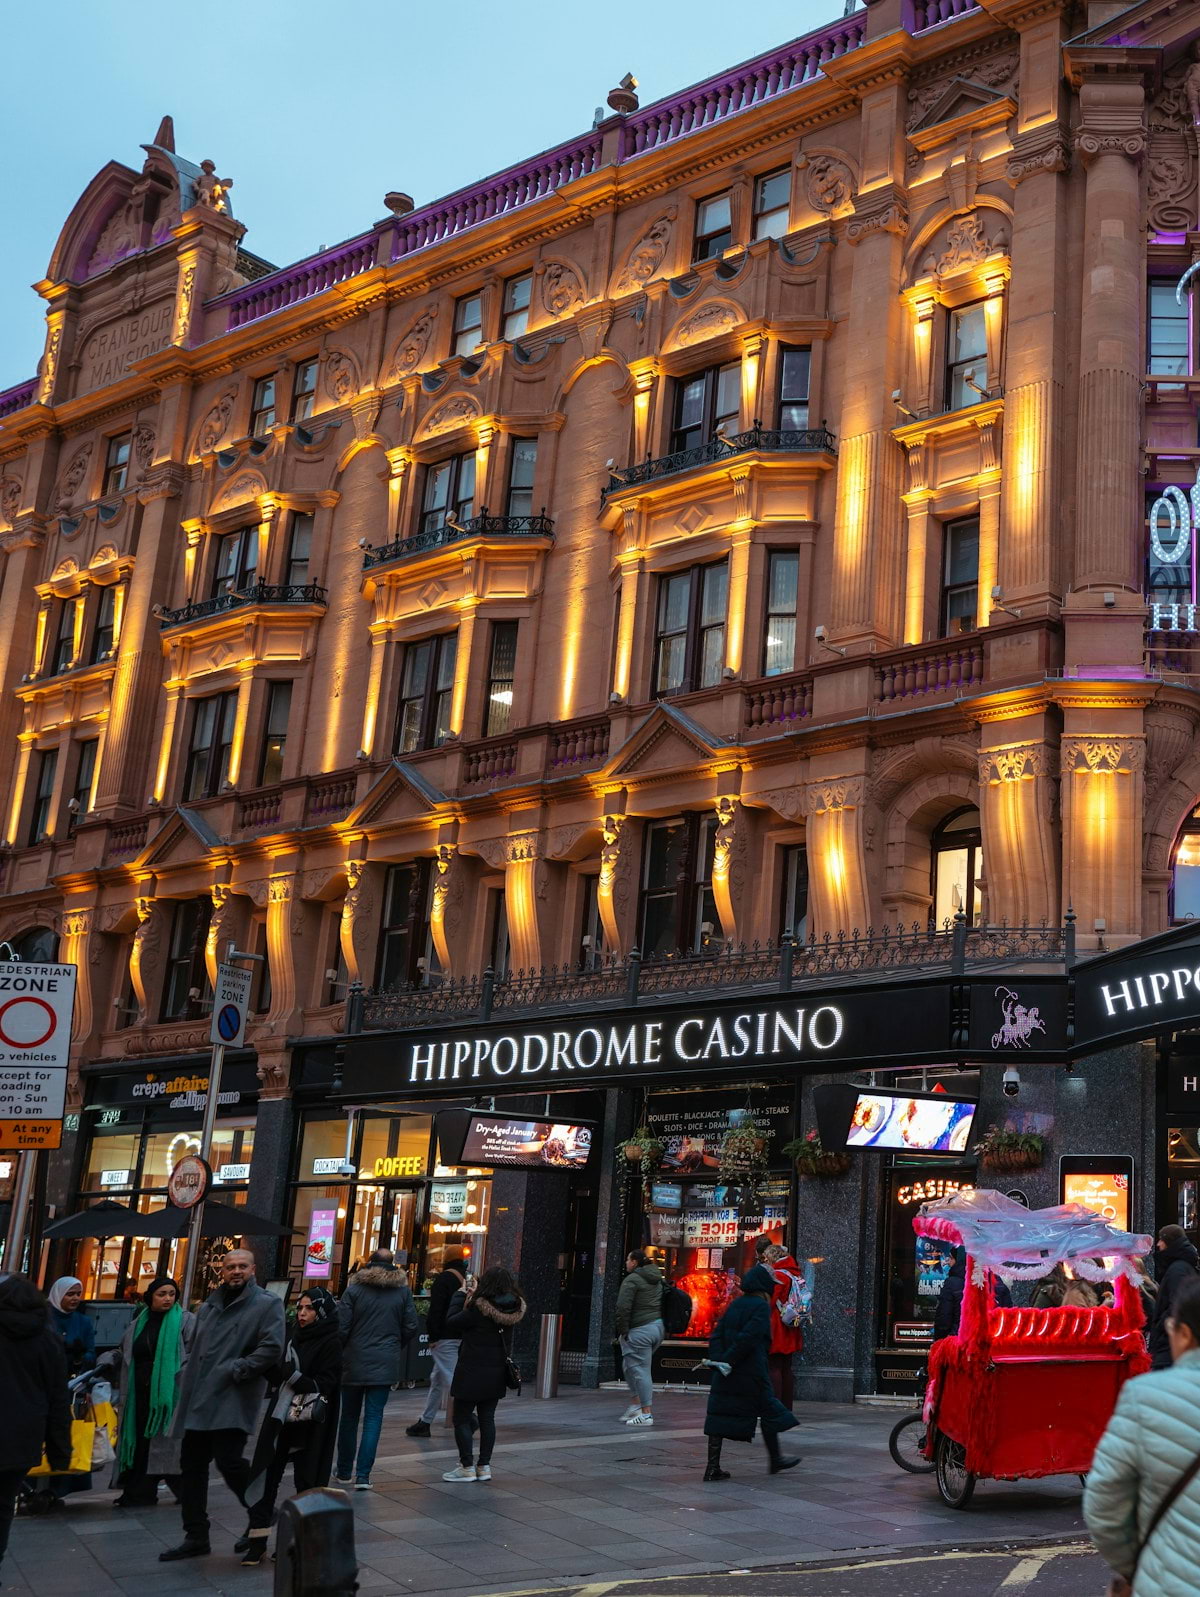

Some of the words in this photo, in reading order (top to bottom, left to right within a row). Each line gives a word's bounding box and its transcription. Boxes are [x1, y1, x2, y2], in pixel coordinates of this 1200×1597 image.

[88, 303, 176, 359] CRANBOUR
[0, 965, 71, 976] EDESTRIAN
[220, 967, 250, 981] Restricted
[0, 978, 58, 992] ZONE
[223, 980, 245, 991] parking
[221, 990, 244, 1003] ZONE
[409, 1023, 662, 1082] HIPPODROME
[673, 1006, 844, 1062] CASINO
[10, 1053, 57, 1061] vehicles
[0, 1073, 31, 1082] xcept
[35, 1072, 52, 1080] for
[0, 1082, 41, 1091] oading
[25, 1094, 48, 1103] Sun
[9, 1106, 22, 1114] 10
[25, 1107, 43, 1115] am
[648, 1113, 679, 1122] ROULETTE
[684, 1110, 720, 1120] BLACKJACK
[765, 1106, 789, 1115] STEAKS
[31, 1126, 52, 1134] any
[475, 1123, 510, 1137] Dry-Aged
[510, 1127, 538, 1140] January
[663, 1124, 683, 1132] SLOTS
[688, 1122, 703, 1131] DICE
[18, 1135, 45, 1144] time
[223, 1165, 246, 1177] SAVOURY
[374, 1156, 421, 1177] COFFEE
[106, 1172, 124, 1183] SWEET
[898, 1178, 976, 1204] CASINO
[659, 1213, 677, 1224] New
[917, 1279, 931, 1288] ALL
